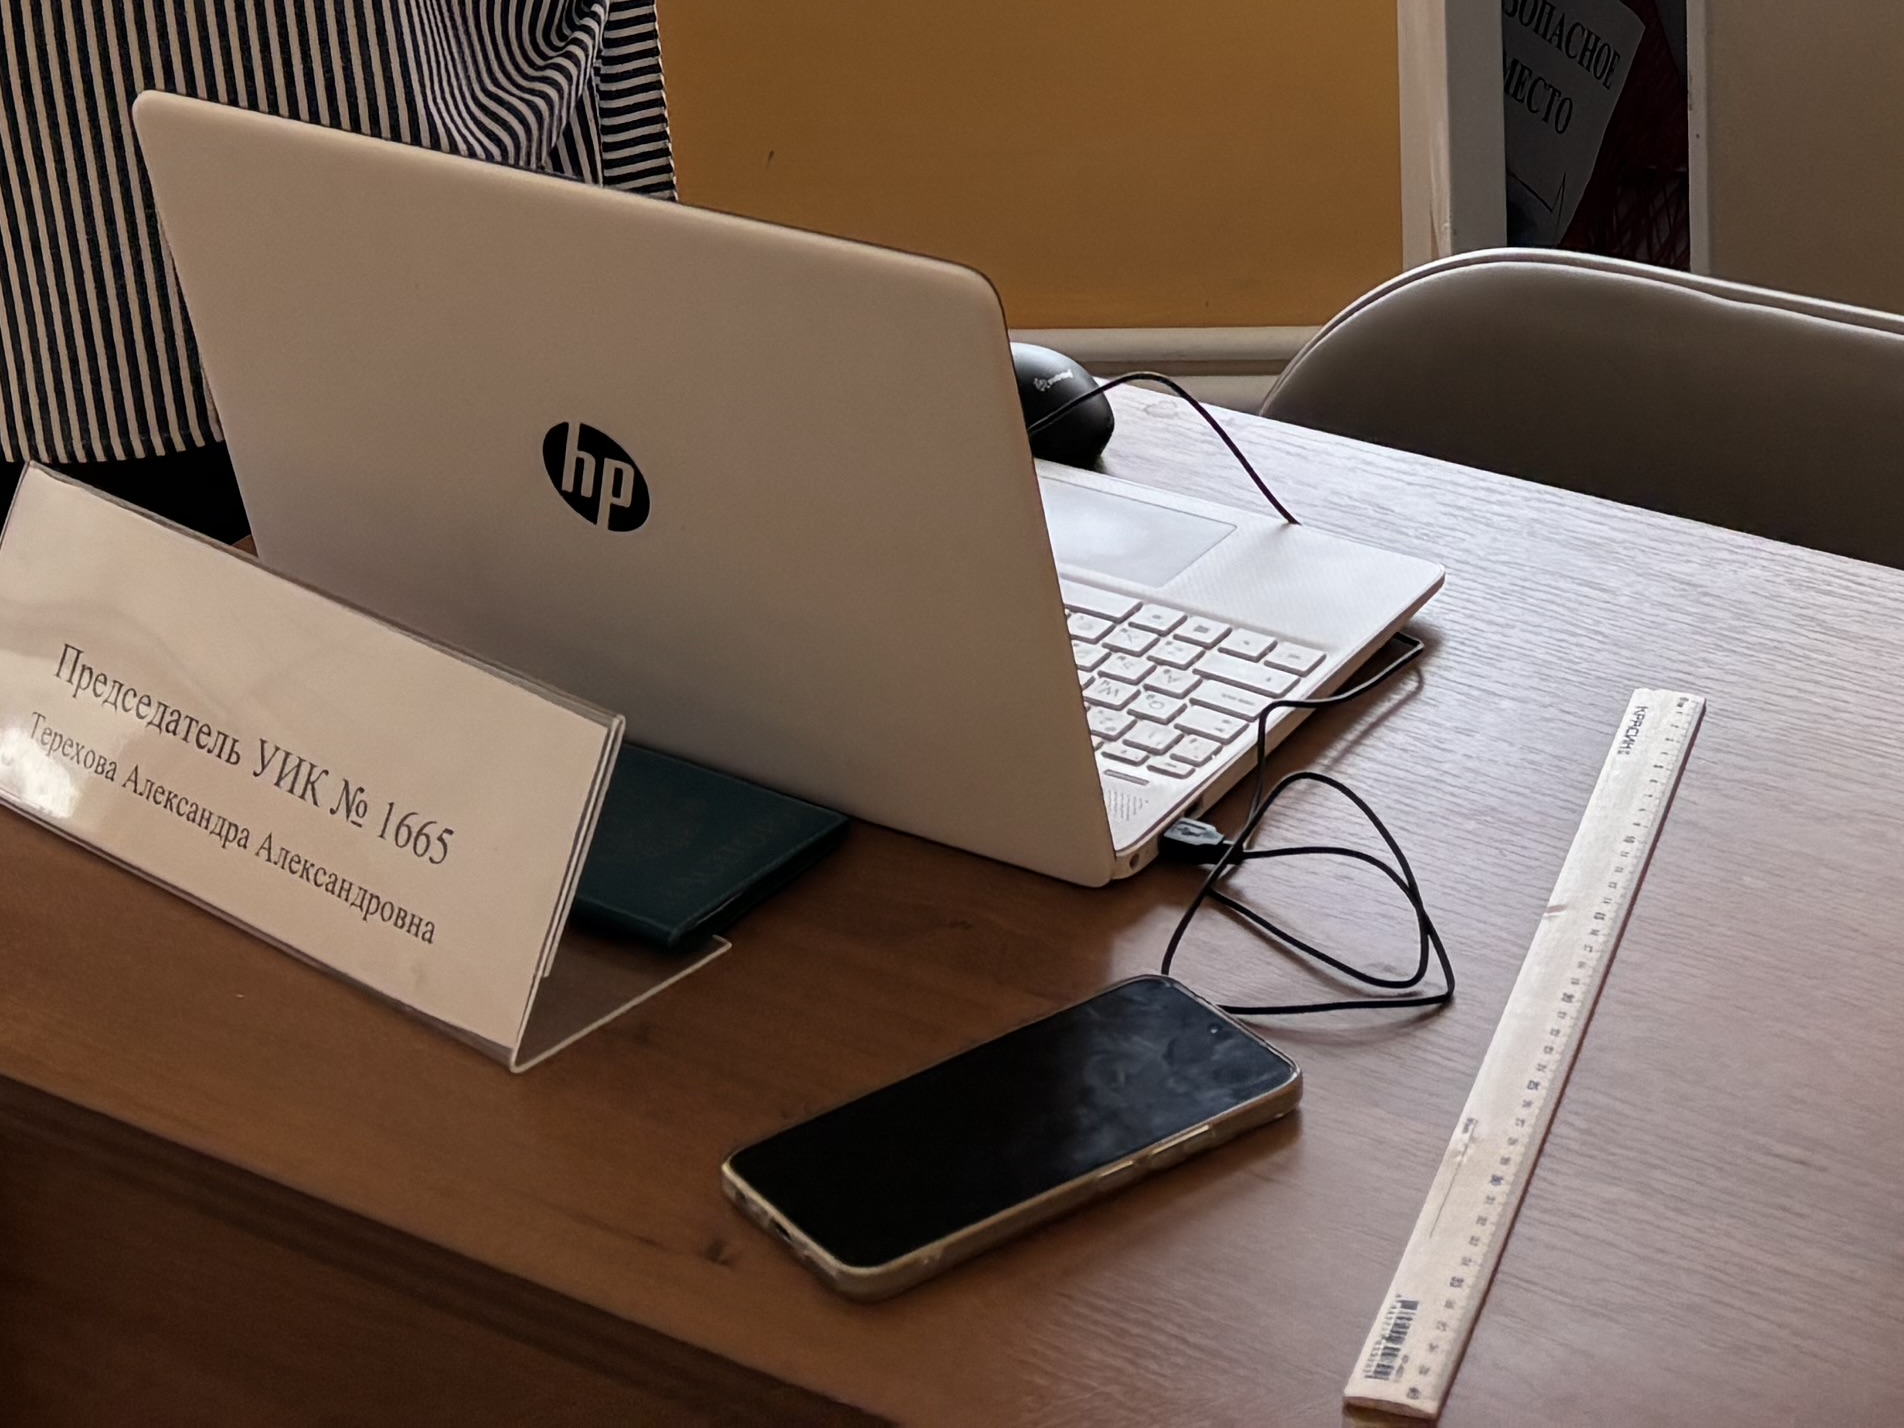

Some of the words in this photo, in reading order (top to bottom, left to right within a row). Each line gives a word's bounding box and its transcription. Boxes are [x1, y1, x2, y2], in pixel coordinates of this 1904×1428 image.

[561, 422, 635, 531] hp
[29, 710, 118, 782] Терехова
[122, 764, 251, 850] Александра
[254, 832, 436, 944] Александровна
[54, 643, 241, 766] Председатель
[252, 738, 330, 807] УИК
[329, 778, 368, 828] №
[378, 802, 454, 865] 1665
